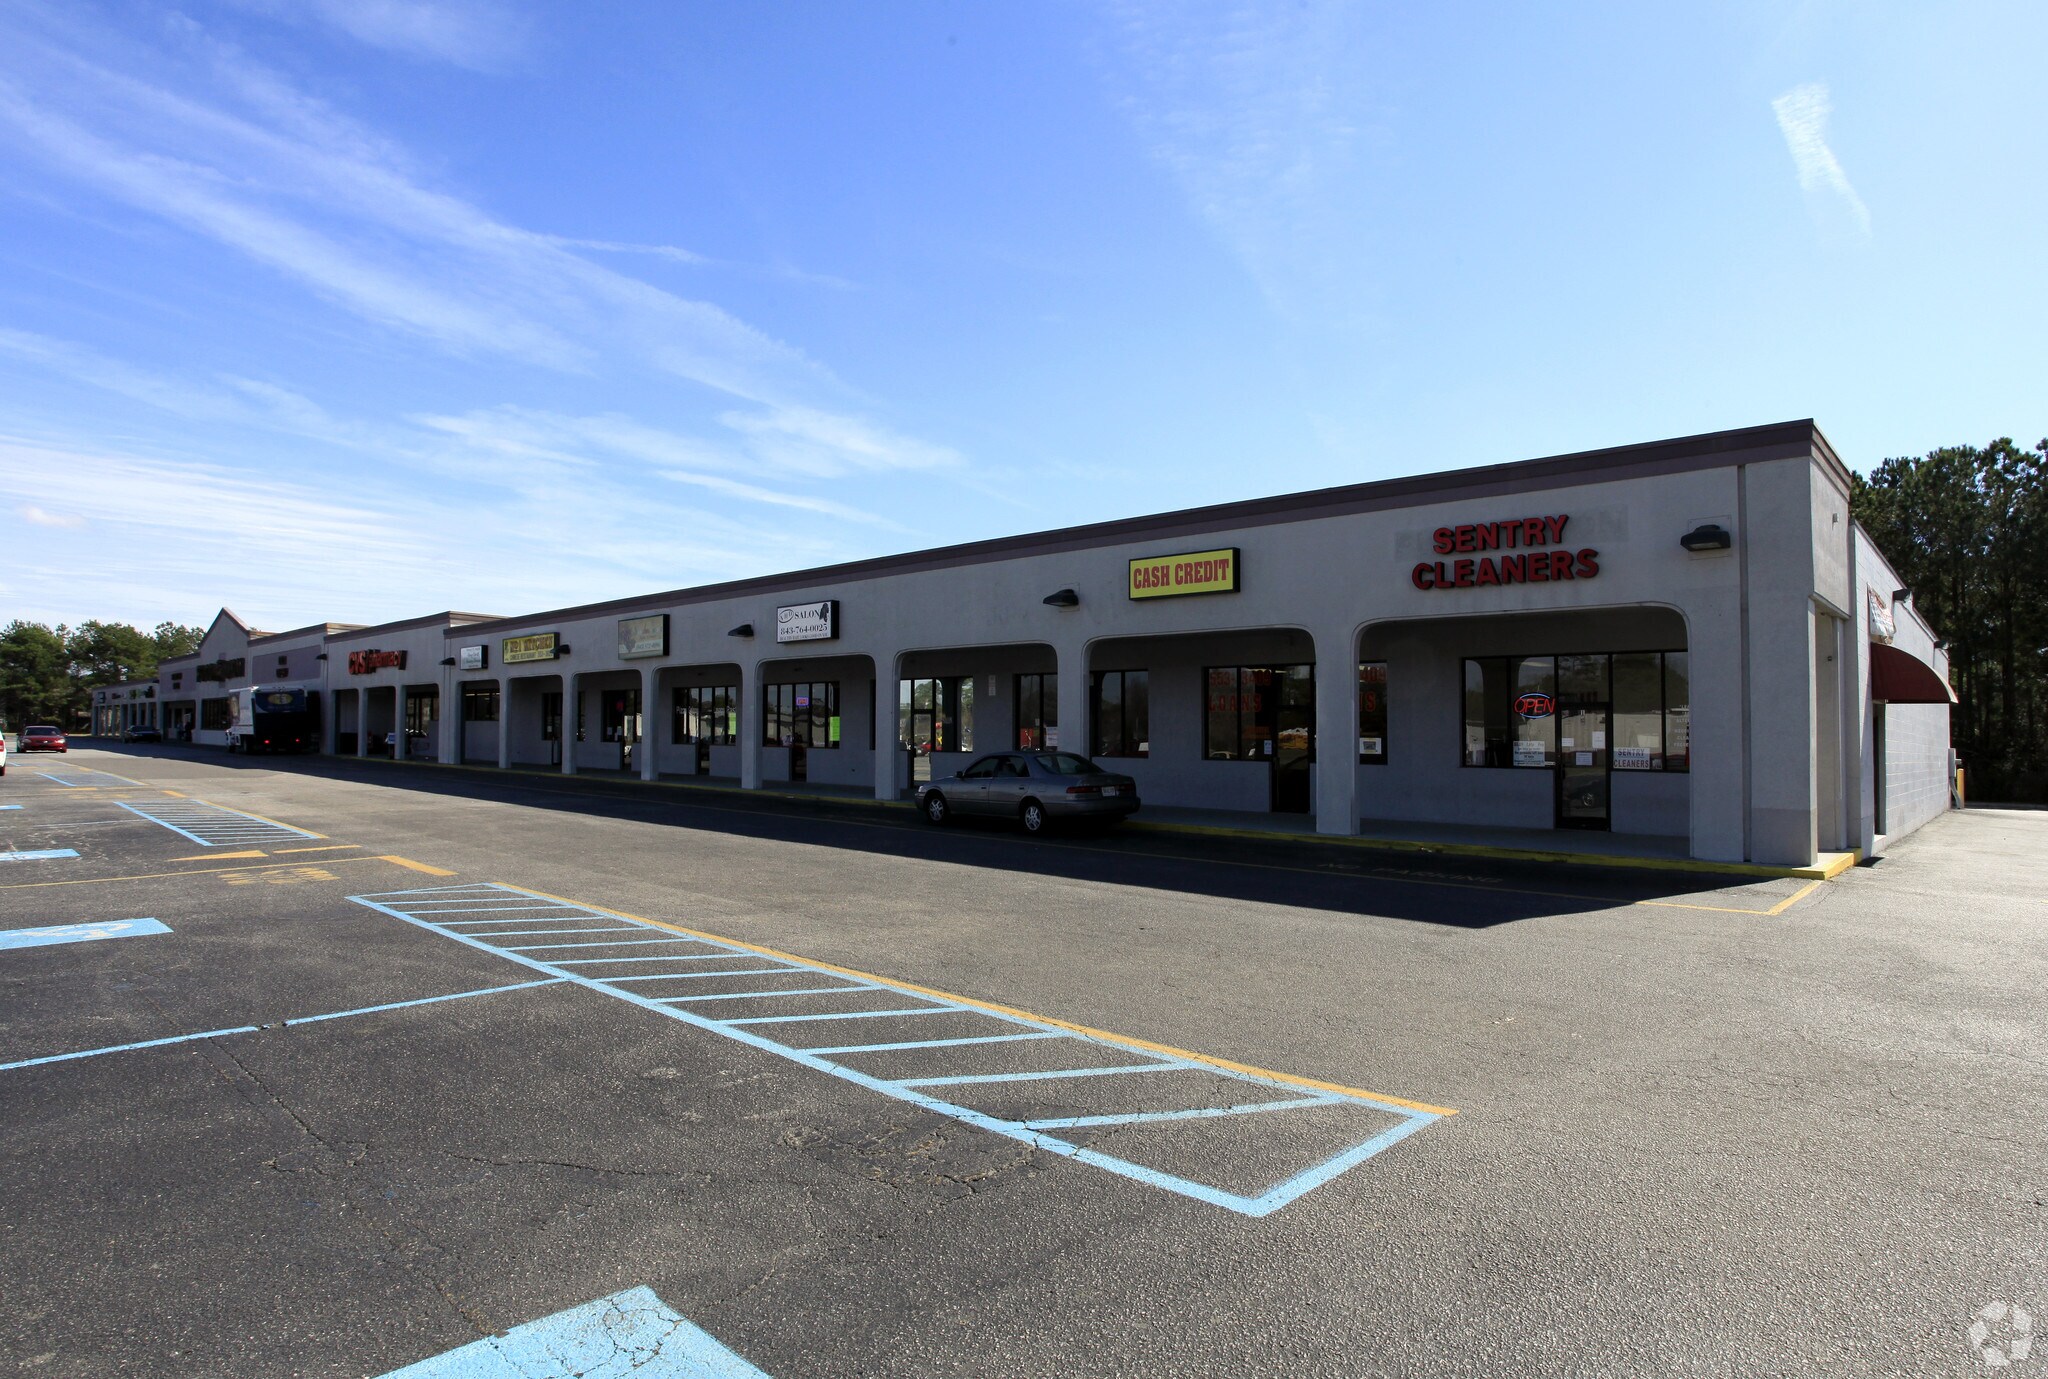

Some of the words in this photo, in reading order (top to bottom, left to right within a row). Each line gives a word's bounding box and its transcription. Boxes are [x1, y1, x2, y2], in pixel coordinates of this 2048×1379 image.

[1433, 515, 1569, 554] SENTRY
[1133, 565, 1170, 589] CASH
[1175, 558, 1229, 585] CREDIT
[1412, 549, 1599, 590] CLEANERS
[795, 609, 820, 620] SALON
[1513, 697, 1557, 714] OPEN
[1618, 748, 1645, 756] SENTRY
[1614, 759, 1649, 768] CLEANERS
